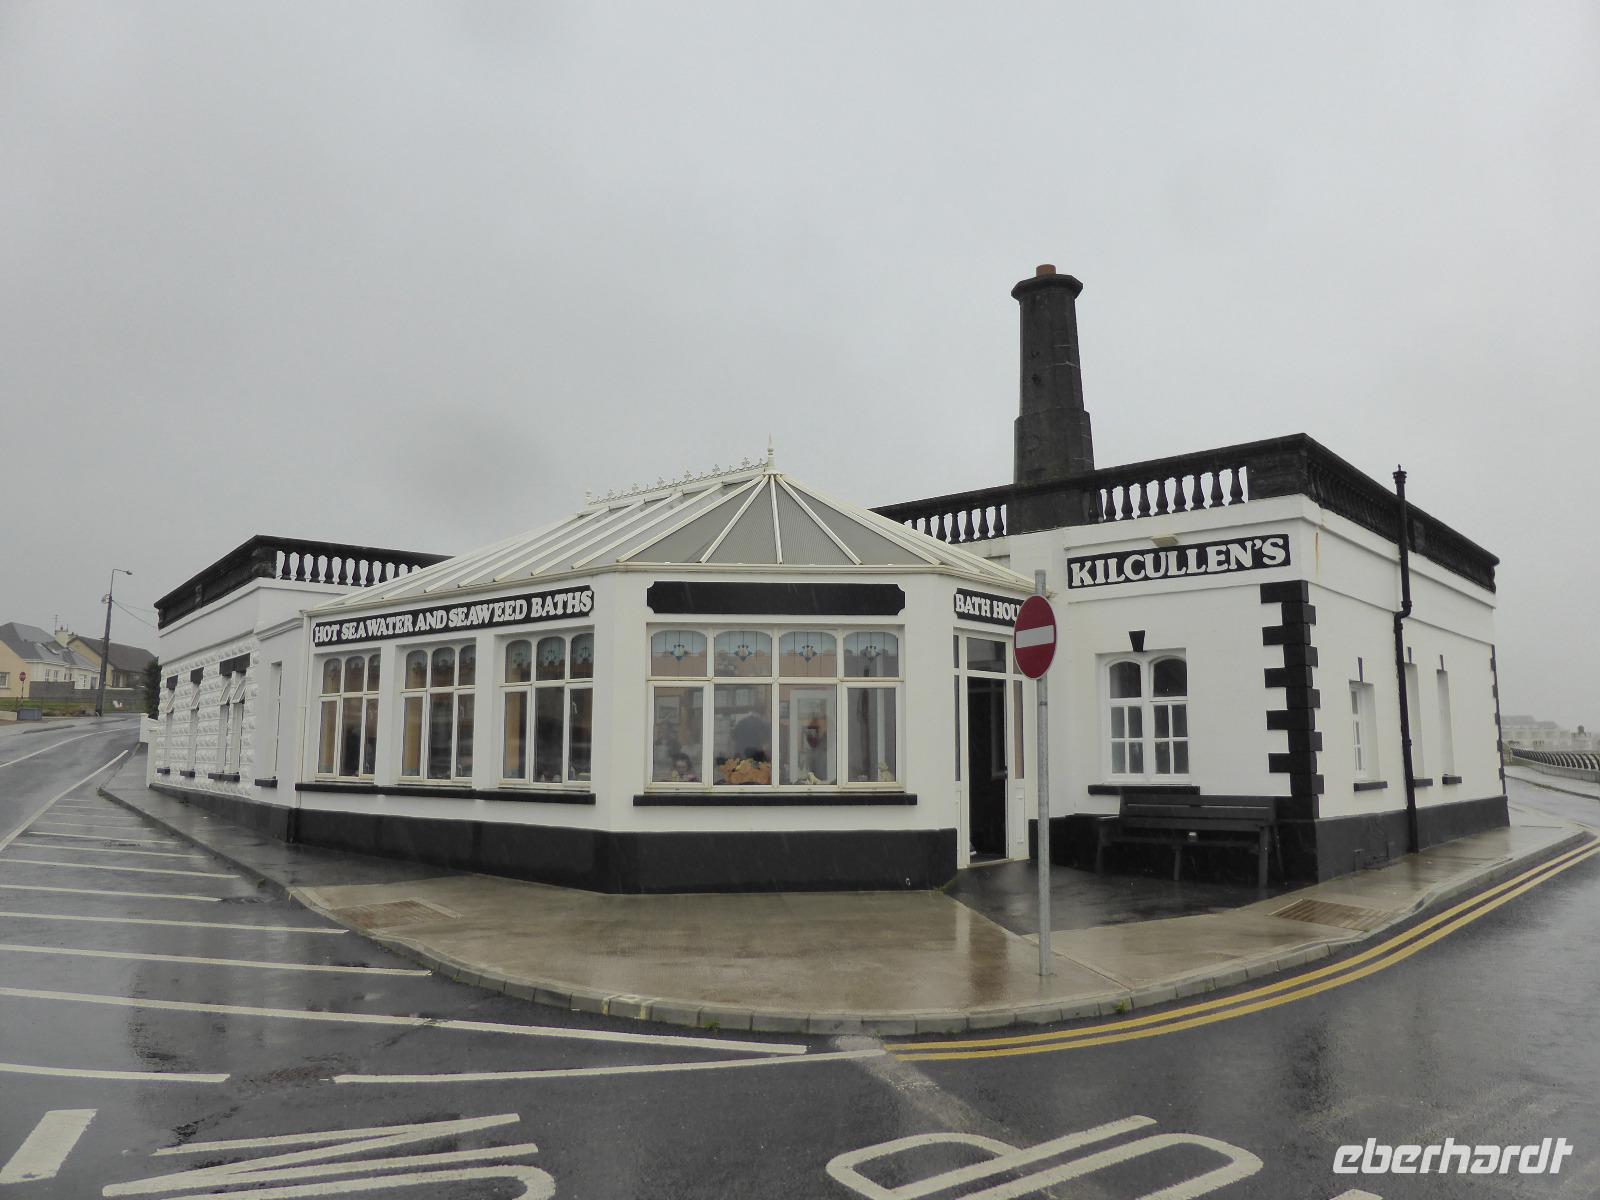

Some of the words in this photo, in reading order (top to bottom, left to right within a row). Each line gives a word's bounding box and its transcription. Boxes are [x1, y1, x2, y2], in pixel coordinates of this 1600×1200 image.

[1070, 537, 1286, 587] KILCULLEN'S
[315, 624, 340, 643] HOT
[415, 609, 447, 632] AND
[448, 599, 528, 627] SEAWEED
[530, 590, 593, 618] BATHS
[955, 593, 991, 618] BATH
[992, 600, 1021, 622] HOU
